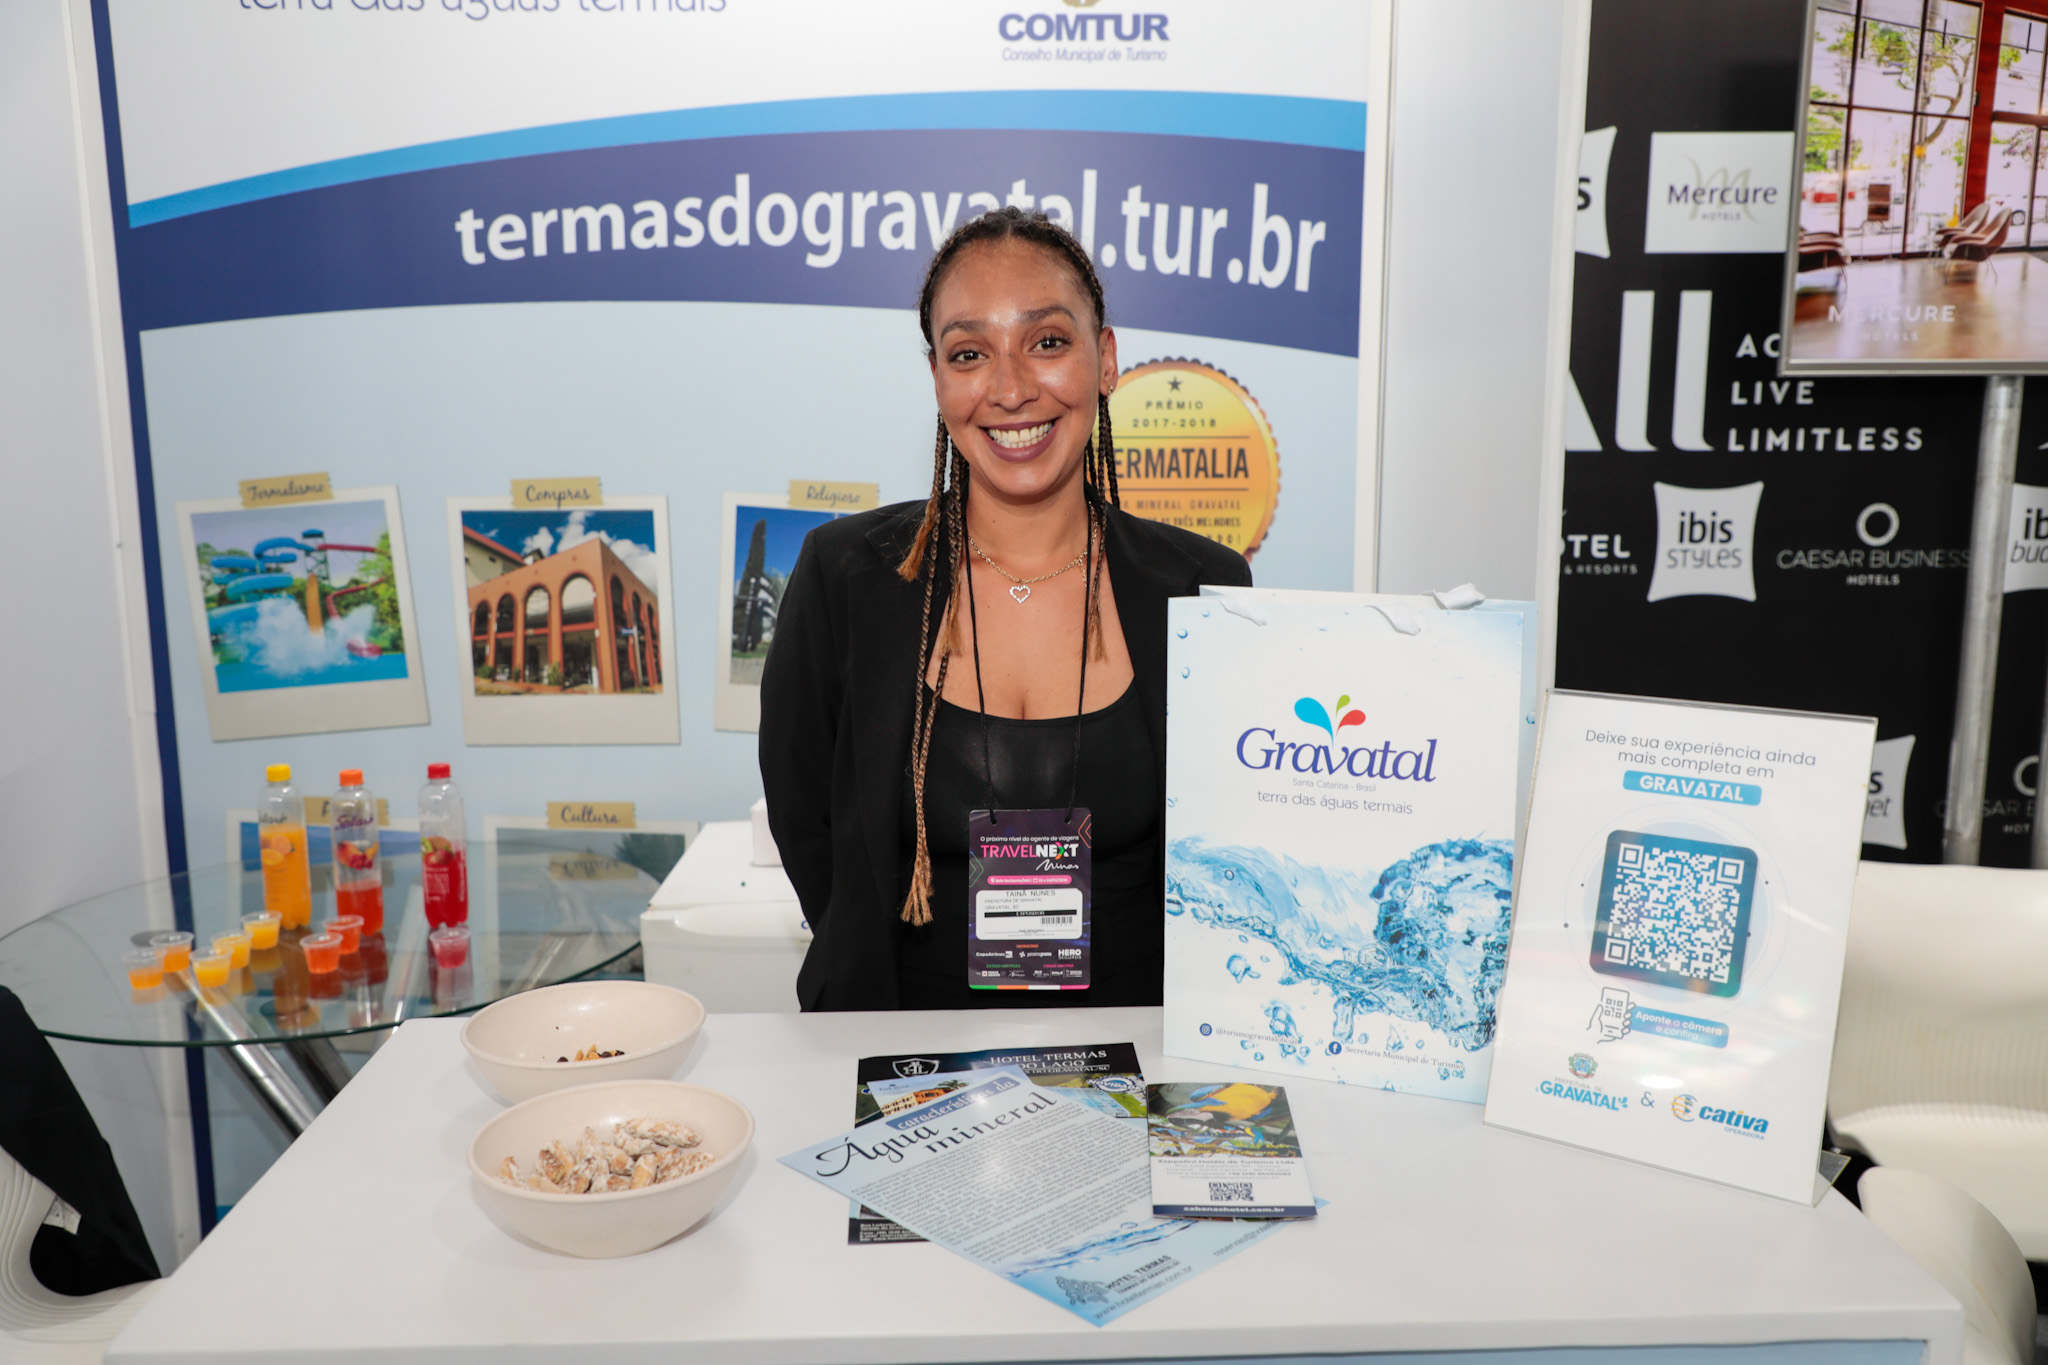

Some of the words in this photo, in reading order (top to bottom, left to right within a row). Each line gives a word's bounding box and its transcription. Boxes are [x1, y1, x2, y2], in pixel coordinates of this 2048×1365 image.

[998, 13, 1170, 41] COMTUR
[1002, 47, 1052, 61] Conselho
[1056, 47, 1104, 63] Municipal
[1108, 47, 1121, 61] de
[1126, 47, 1167, 61] Turismo
[1667, 184, 1778, 205] Mercure
[1702, 212, 1741, 221] HOTELS
[1828, 305, 1956, 323] MERCURE
[1731, 380, 1814, 405] LIVE
[1146, 399, 1204, 410] PRÊMIO
[1132, 418, 1217, 428] 2017-2018
[1728, 427, 1923, 452] LIMITLESS
[1096, 447, 1249, 479] ERMATALIA
[525, 484, 591, 510] Compras
[806, 484, 861, 508] Religioso
[1137, 500, 1182, 510] MINERAL
[1190, 500, 1241, 510] GRAVATAL
[1679, 511, 1734, 544] ibis
[1576, 563, 1638, 576] RESORTS
[1777, 550, 1864, 569] CAESAR
[1870, 550, 1974, 569] BUSINESS
[1846, 574, 1900, 585] HOTELS
[1236, 727, 1437, 783] Gravatal
[1585, 729, 1627, 745] Deixe
[1631, 735, 1659, 749] sua
[1664, 740, 1761, 761] experiência
[1766, 749, 1816, 766] ainda
[1618, 750, 1656, 765] mais
[1661, 754, 1741, 775] completa
[1746, 767, 1774, 779] em
[1292, 777, 1314, 788] Santa
[1316, 779, 1349, 790] Catarina
[1356, 783, 1377, 792] Brasil
[1639, 774, 1744, 801] GRAVATAL
[1258, 790, 1287, 803] terra
[1292, 791, 1316, 806] das
[1320, 794, 1359, 810] águas
[1363, 800, 1413, 814] termais
[561, 805, 619, 825] Cultura
[980, 843, 1080, 859] TRAVELNEXT
[1035, 858, 1079, 872] Minas
[1031, 889, 1056, 897] NUNES
[1635, 1010, 1671, 1027] Aponte
[1673, 1019, 1681, 1028] a
[1682, 1019, 1723, 1036] câmera
[1656, 1025, 1663, 1034] e
[1664, 1024, 1699, 1041] confira
[990, 1055, 1041, 1065] HOTEL
[1043, 1050, 1107, 1062] TERMAS
[1041, 1060, 1085, 1069] LAGO
[1345, 1045, 1381, 1059] Secretaria
[1382, 1050, 1420, 1064] Municipal
[1420, 1056, 1430, 1065] de
[1431, 1058, 1463, 1070] Turismo
[996, 1080, 1015, 1092] da
[1540, 1080, 1620, 1111] GRAVATAL
[1640, 1091, 1655, 1108] &
[925, 1092, 1057, 1154] mineral
[1698, 1104, 1769, 1134] cativa
[1724, 1126, 1765, 1141] OPERADORA
[815, 1124, 940, 1177] Água
[1105, 1271, 1134, 1290] HOTEL
[1134, 1255, 1172, 1275] TERMAS
